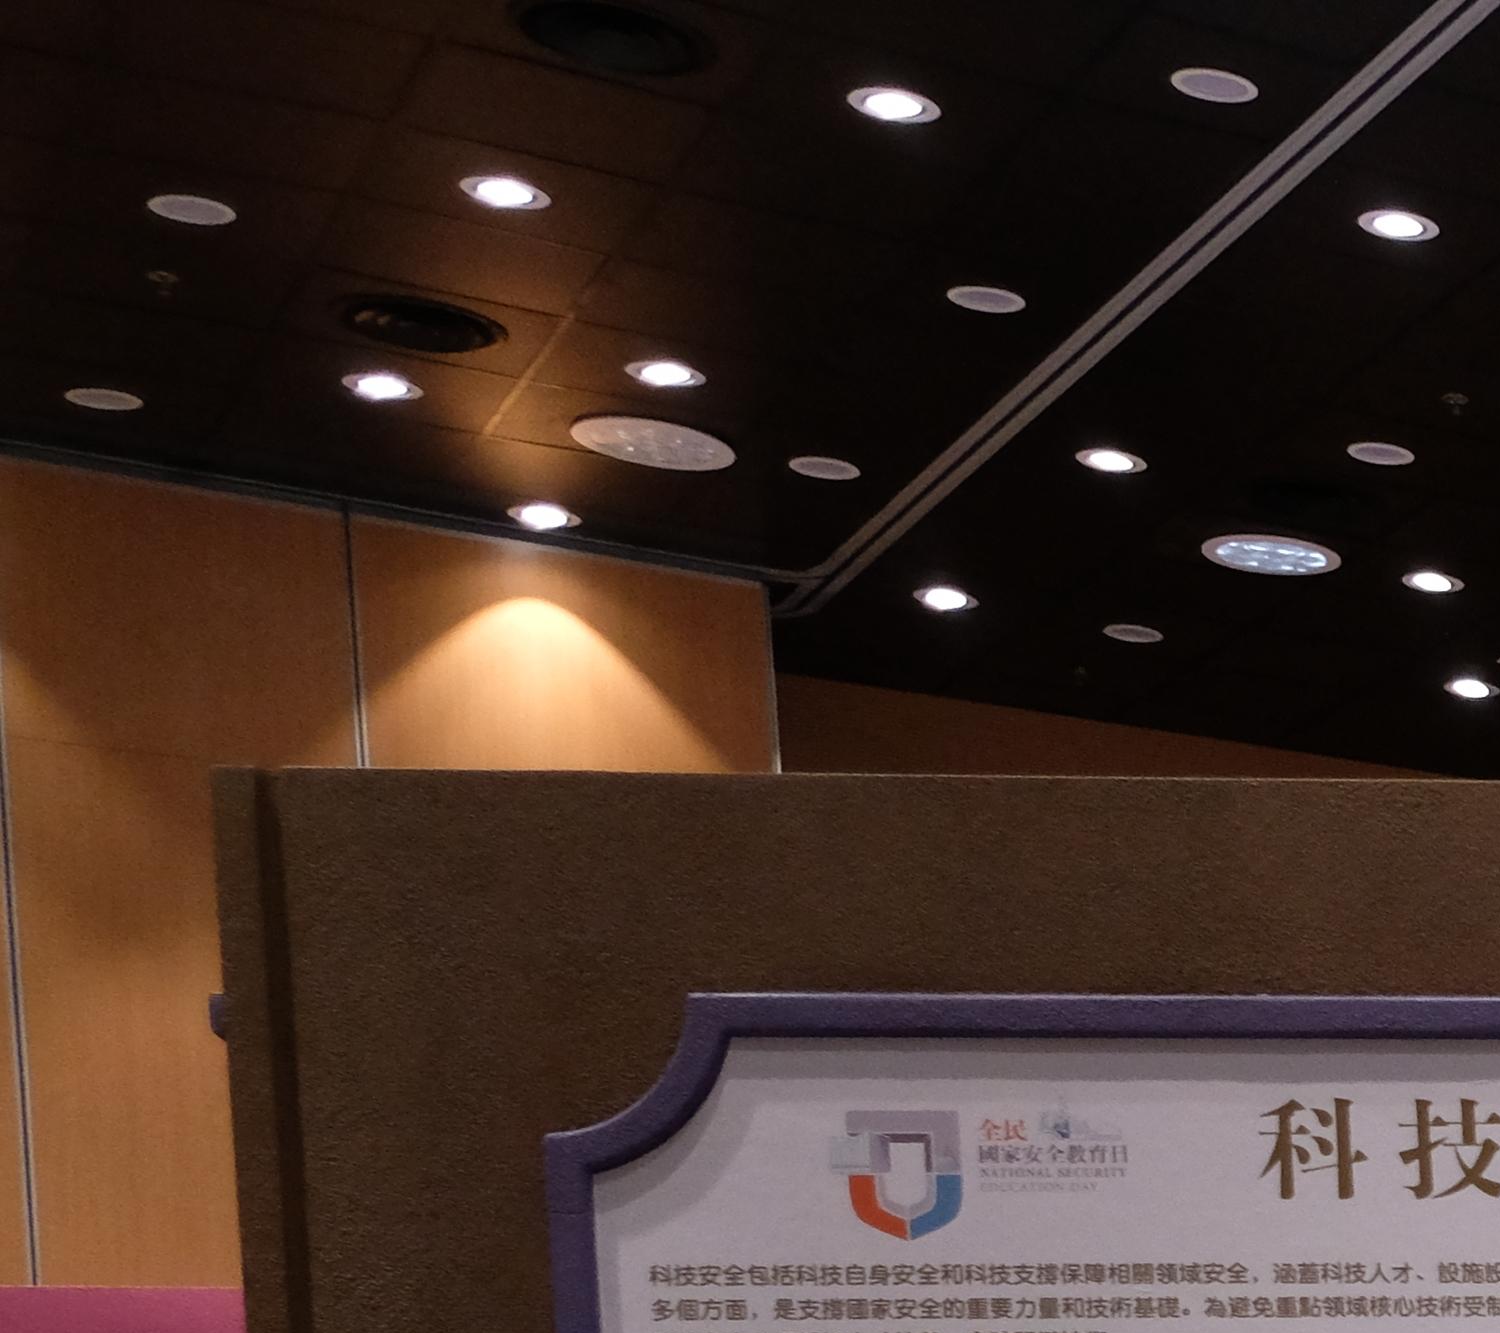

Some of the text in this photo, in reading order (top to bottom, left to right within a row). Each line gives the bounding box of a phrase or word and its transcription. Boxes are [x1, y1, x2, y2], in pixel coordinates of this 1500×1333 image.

[979, 1118, 1028, 1142] 全民
[978, 1145, 1129, 1164] 國家安全教育日
[979, 1167, 1127, 1178] NATIONAL SECURITY
